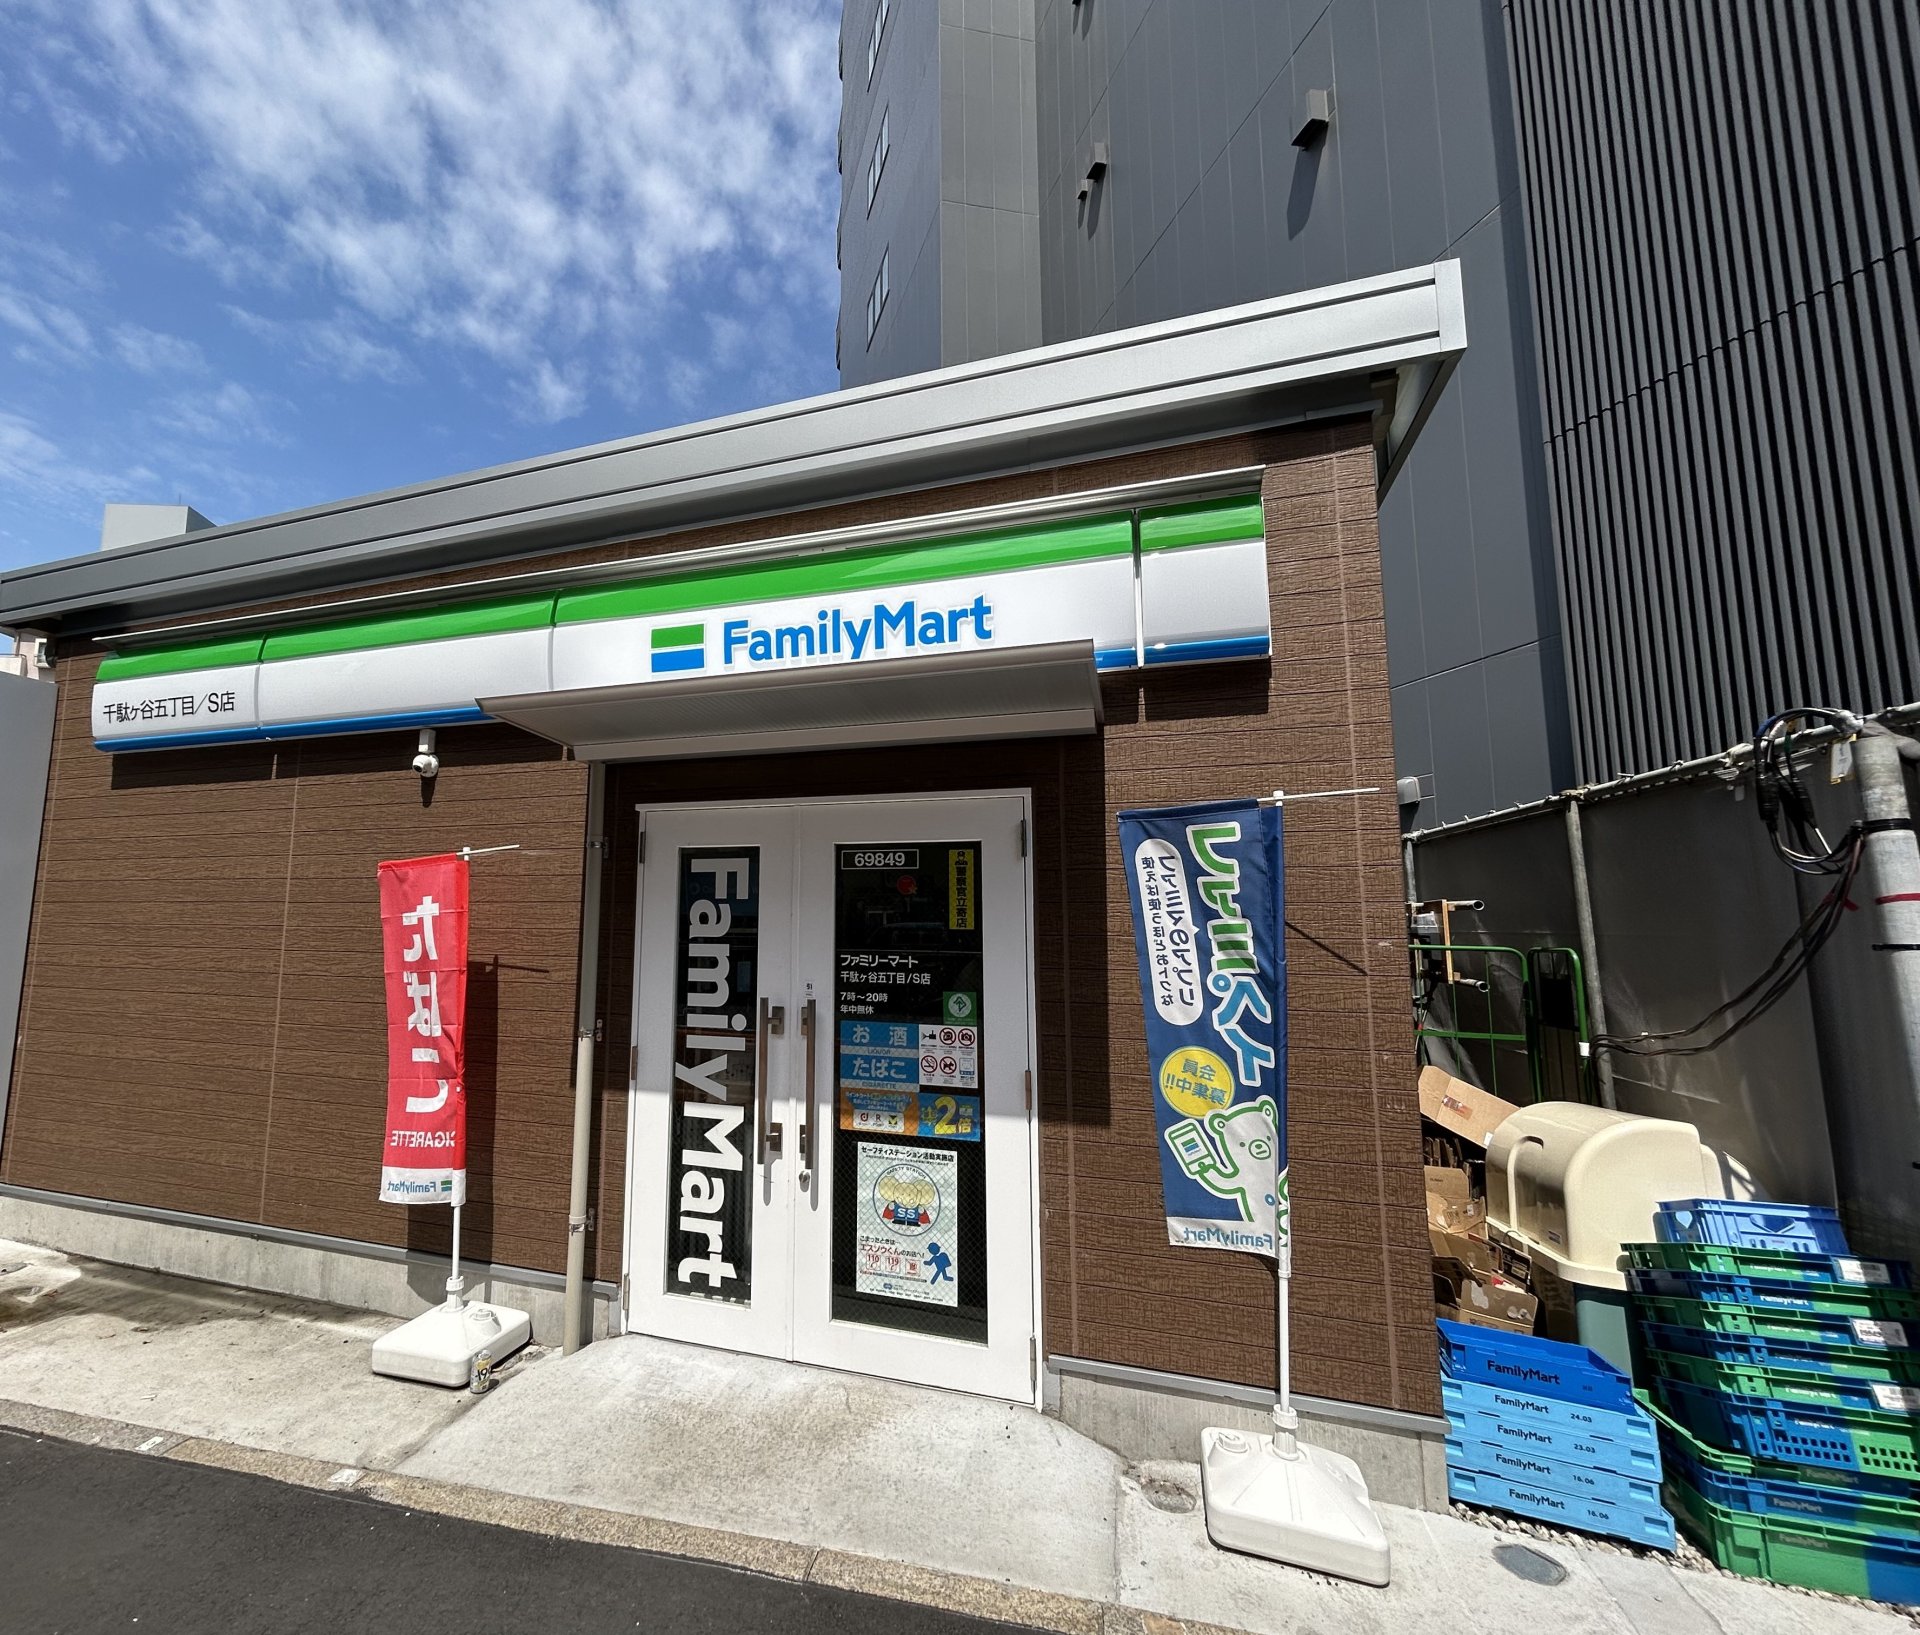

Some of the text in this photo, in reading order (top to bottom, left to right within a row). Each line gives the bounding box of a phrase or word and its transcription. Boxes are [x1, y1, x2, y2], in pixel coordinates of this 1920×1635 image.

[723, 593, 993, 665] FamilyMart
[854, 852, 906, 867] 69849
[840, 954, 919, 968] ファミリーマート
[840, 1004, 875, 1014] 年中無休
[867, 1048, 891, 1056] LIQUOR
[674, 857, 749, 1288] FamilyMart
[852, 1057, 907, 1079] たばこ
[861, 1080, 897, 1090] CIGARETTE
[861, 1145, 955, 1163] セーフティステーション活動実施店
[886, 1165, 927, 1180] SAFETY STATION
[897, 1208, 916, 1219] SS
[867, 1253, 879, 1263] 110
[1487, 1360, 1561, 1386] FamilyMart
[1494, 1394, 1593, 1424] FamilyMart 24.03
[1497, 1424, 1553, 1445] FamilyMart
[1495, 1453, 1551, 1475] FamilyMart
[1806, 1468, 1859, 1485] FamilyMart
[1509, 1488, 1565, 1510] FamilyMart
[1773, 1496, 1823, 1514] FamilyMart
